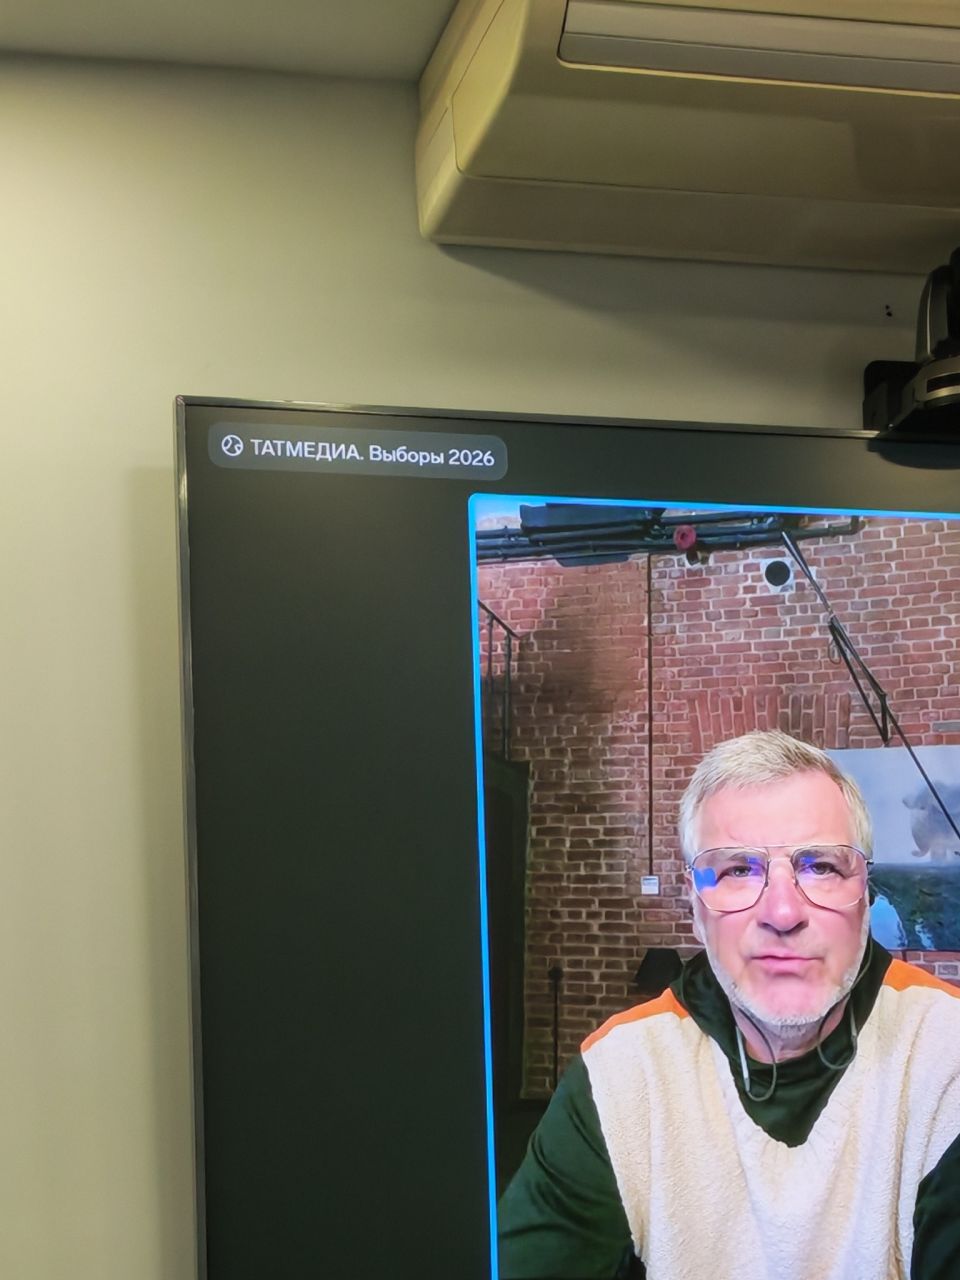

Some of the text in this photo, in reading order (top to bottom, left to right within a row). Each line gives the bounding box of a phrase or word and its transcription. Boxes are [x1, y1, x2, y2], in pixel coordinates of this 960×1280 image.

[250, 439, 494, 466] ТАТМЕДИА. Выборы 2026
